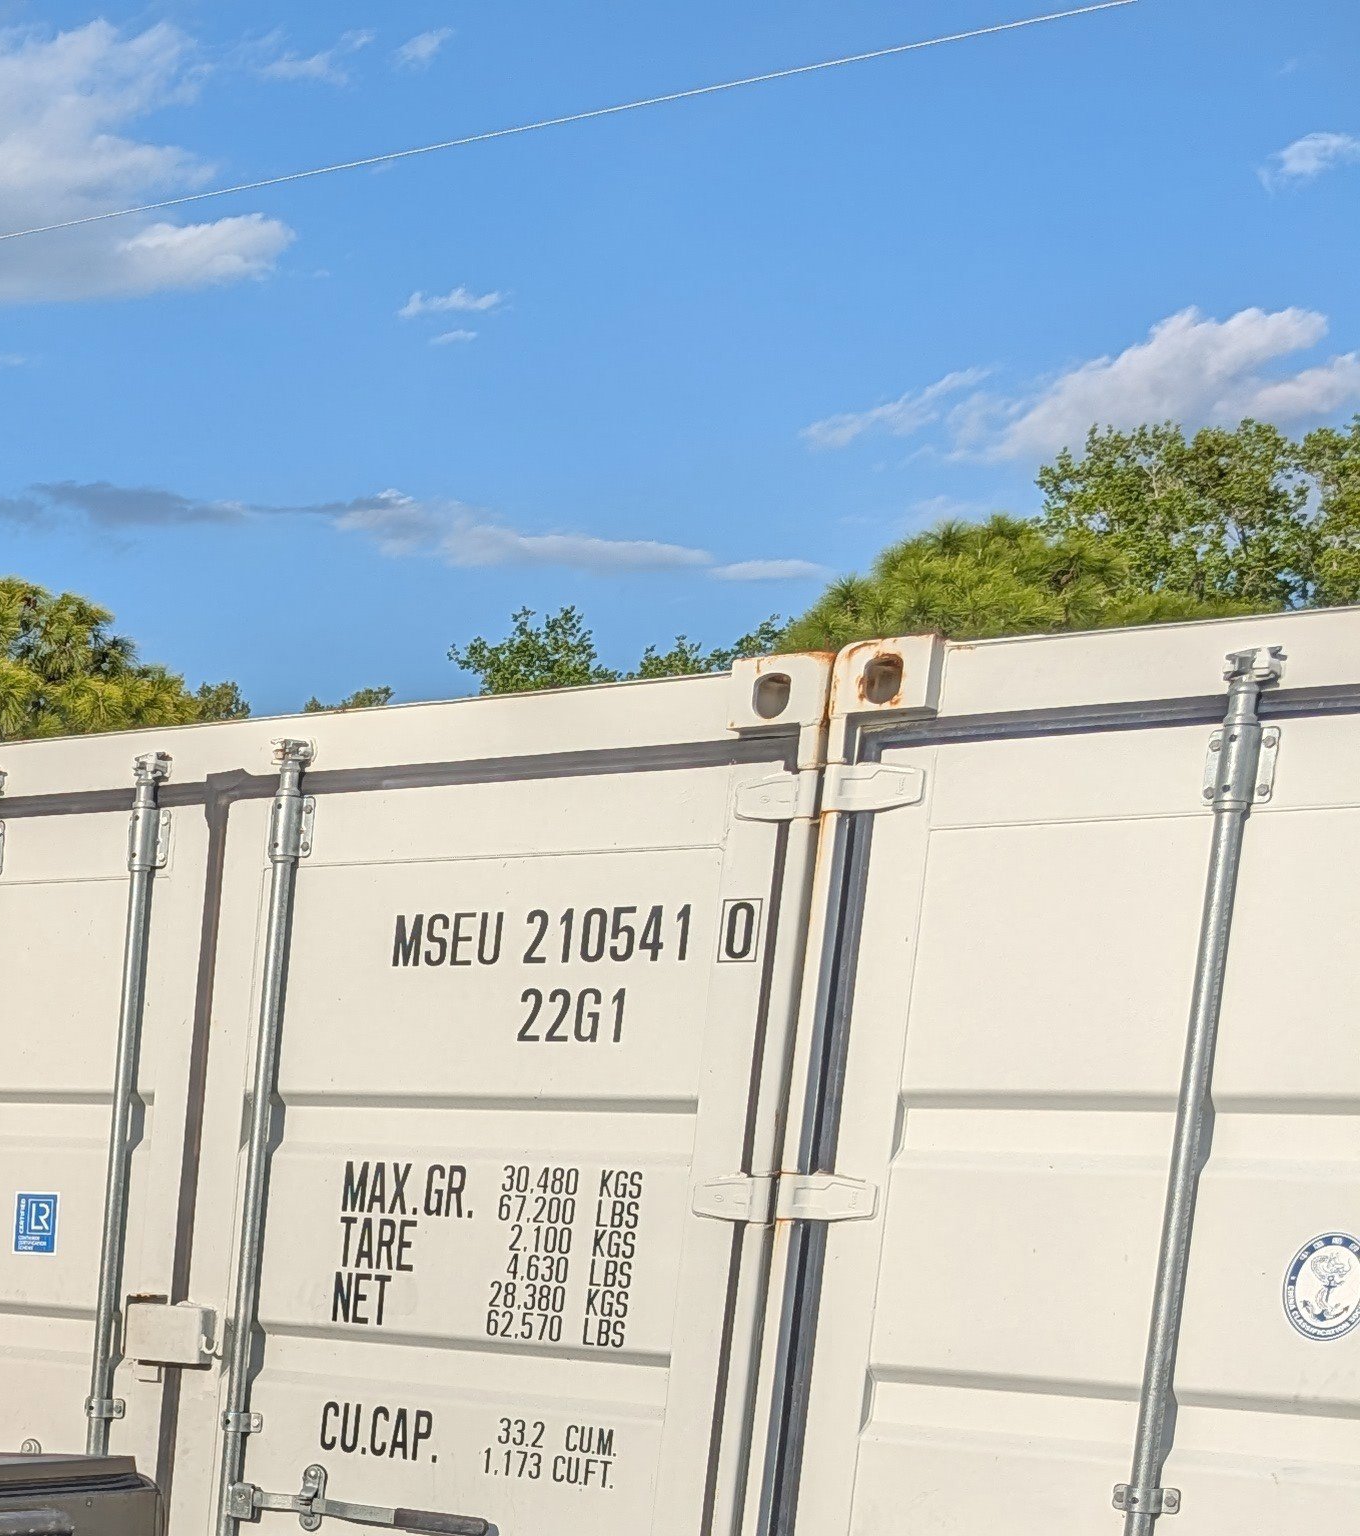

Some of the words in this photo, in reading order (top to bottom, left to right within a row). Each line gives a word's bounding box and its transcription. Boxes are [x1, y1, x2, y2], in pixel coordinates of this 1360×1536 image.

[392, 912, 504, 966] MSEU
[523, 904, 691, 963] 210541
[725, 902, 754, 959] 0
[517, 988, 625, 1042] 22G1
[342, 1161, 473, 1218] MAX.GR.
[502, 1165, 579, 1195] 30,480
[599, 1170, 642, 1199] KGS
[498, 1194, 575, 1225] 67,200
[596, 1200, 639, 1229] LBS
[341, 1216, 417, 1272] TARE
[509, 1224, 572, 1254] 2,100
[592, 1229, 635, 1259] KGS
[507, 1253, 568, 1284] 4,630
[589, 1259, 632, 1289] LBS
[332, 1272, 392, 1325] NET
[489, 1281, 565, 1313] 28,380
[586, 1289, 628, 1318] KGS
[486, 1310, 562, 1342] 62,570
[583, 1318, 625, 1348] LBS
[321, 1402, 437, 1463] CU.CAP.
[498, 1418, 545, 1448] 33.2
[566, 1425, 616, 1457] CU.M.
[485, 1448, 541, 1479] 1,173
[553, 1451, 616, 1489] CU.FT.
